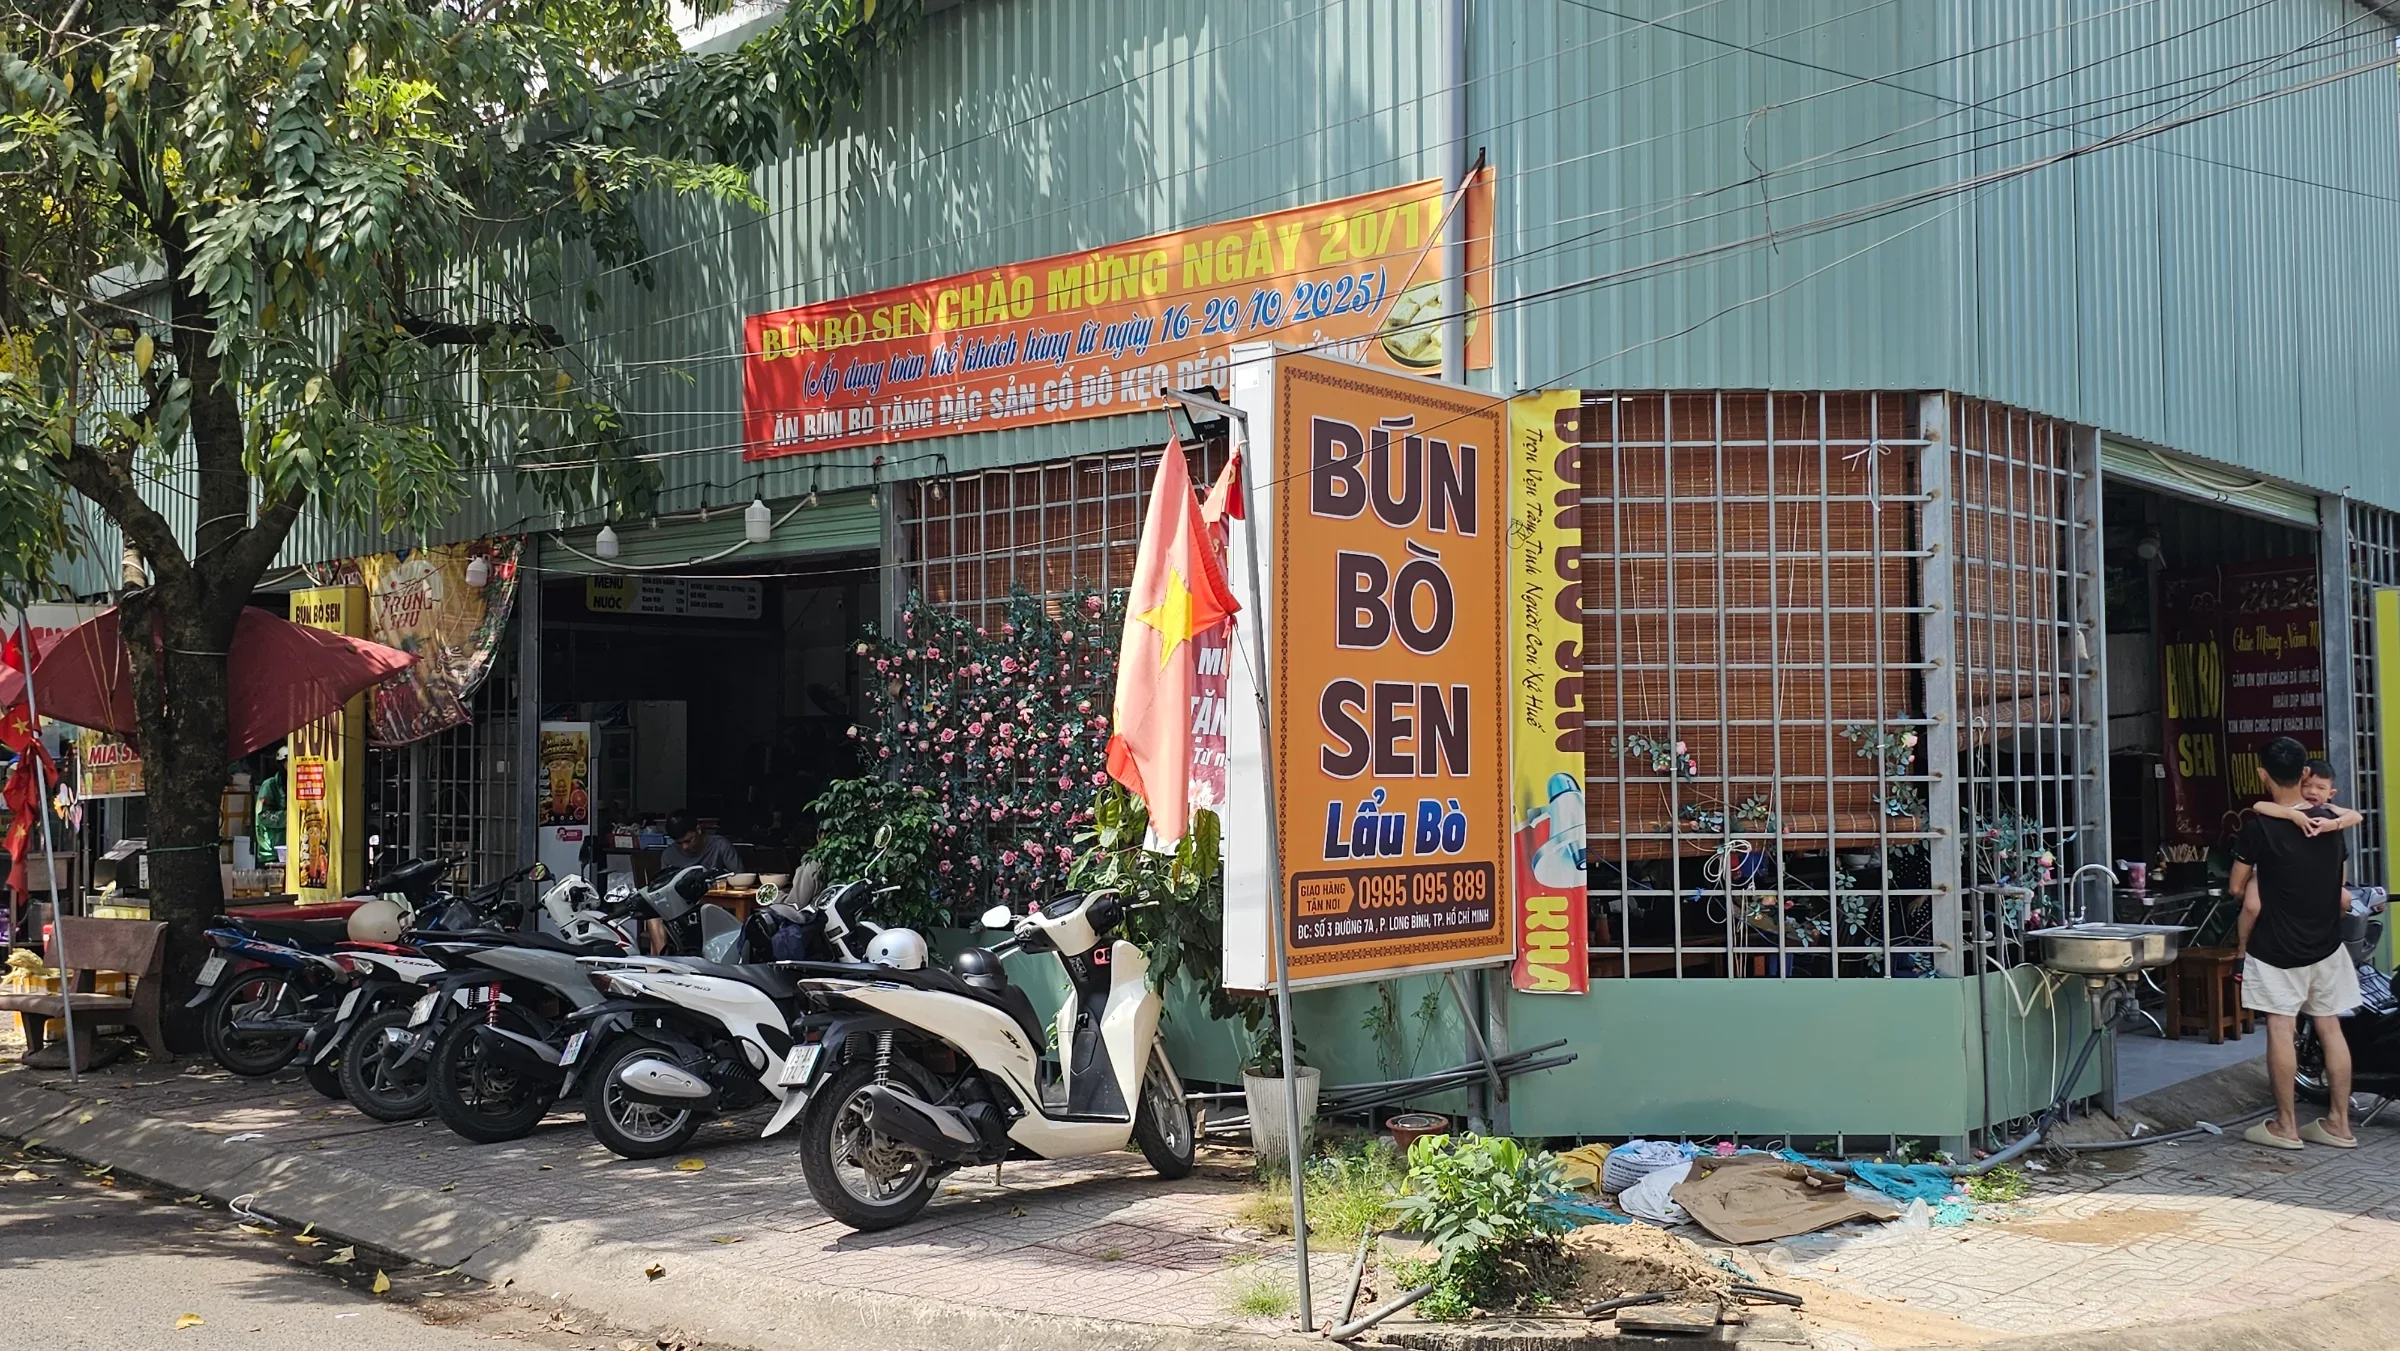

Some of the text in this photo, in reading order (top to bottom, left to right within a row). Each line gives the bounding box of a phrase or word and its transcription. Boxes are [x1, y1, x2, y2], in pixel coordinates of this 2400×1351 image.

[762, 318, 819, 362] BÚN
[824, 305, 866, 351] BÒ
[872, 300, 930, 341] SEN
[938, 272, 1034, 331] CHÀO
[1048, 249, 1167, 312] MỪNG
[1182, 220, 1304, 288] NGÀY
[843, 357, 884, 398] dụng
[887, 350, 925, 383] toàn
[929, 334, 963, 377] thể
[961, 330, 1019, 372] khách
[1021, 328, 1072, 368] hàng
[1076, 319, 1102, 354] từ
[1102, 312, 1155, 361] ngày
[773, 412, 798, 446] ĂN
[849, 400, 874, 437] BÒ
[880, 395, 934, 438] TẶNG
[939, 386, 982, 430] ĐẶC
[989, 375, 1036, 420] SẢN
[1043, 365, 1074, 412] CỐ
[1081, 366, 1113, 408] ĐÔ
[1121, 364, 1169, 407] KẸO
[1522, 429, 1543, 464] Trọn
[1311, 414, 1477, 537] BÚN
[1522, 468, 1543, 497] Vẹn
[594, 577, 623, 590] MENU
[1337, 538, 1455, 655] BÒ
[296, 599, 341, 625] BÚN BÒ SEN
[1526, 633, 1543, 665] Con
[2166, 629, 2222, 720] BÚN BÒ
[1319, 677, 1471, 780] SEN
[1525, 694, 1546, 734] Huế
[87, 743, 119, 767] MIA
[2178, 733, 2217, 778] SEN
[1323, 786, 1467, 861] Lẩu Bò
[1300, 881, 1346, 897] GIAO HÀNG
[1306, 899, 1323, 915] TẬN
[1358, 869, 1487, 910] 0995 095 889
[1298, 924, 1313, 940] ĐC:
[1314, 917, 1327, 938] SỐ
[1327, 922, 1333, 937] 3
[1334, 917, 1362, 936] ĐƯỜNG
[1389, 915, 1410, 931] LONG
[1432, 912, 1445, 927] TP.
[1457, 907, 1471, 925] CHÍ
[1471, 908, 1489, 924] MINH
